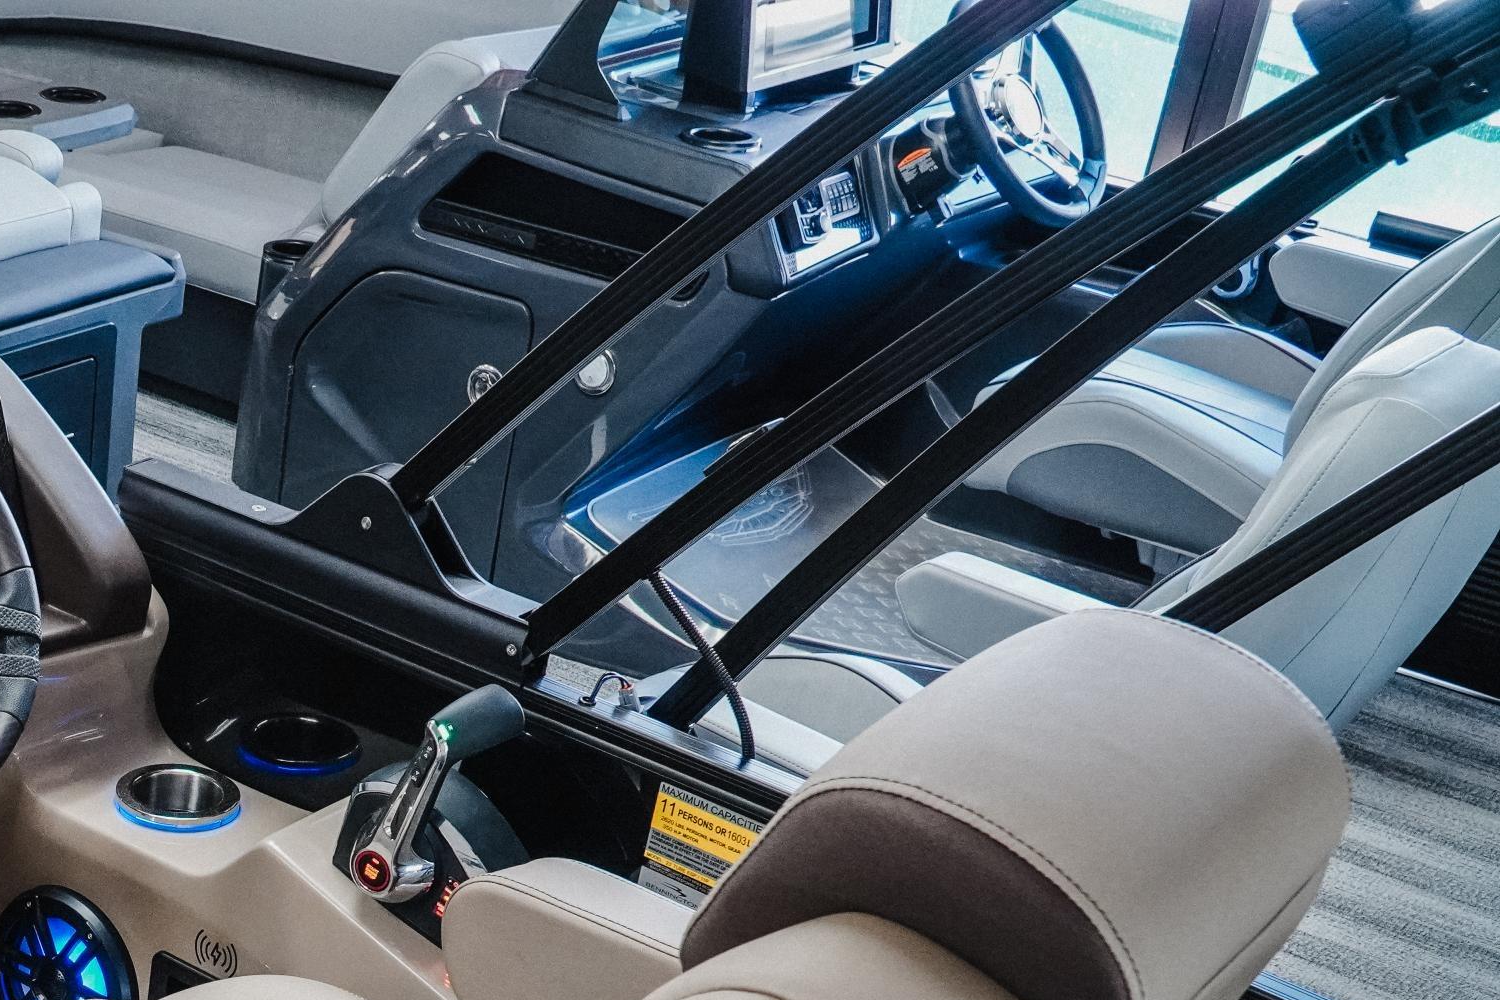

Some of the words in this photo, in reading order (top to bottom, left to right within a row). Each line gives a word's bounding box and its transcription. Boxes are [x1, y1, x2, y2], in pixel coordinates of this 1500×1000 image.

[661, 784, 710, 812] MAXIMUM
[660, 798, 676, 817] 11
[677, 809, 714, 831] PERSONS
[715, 825, 727, 837] OR
[727, 830, 747, 847] 1603
